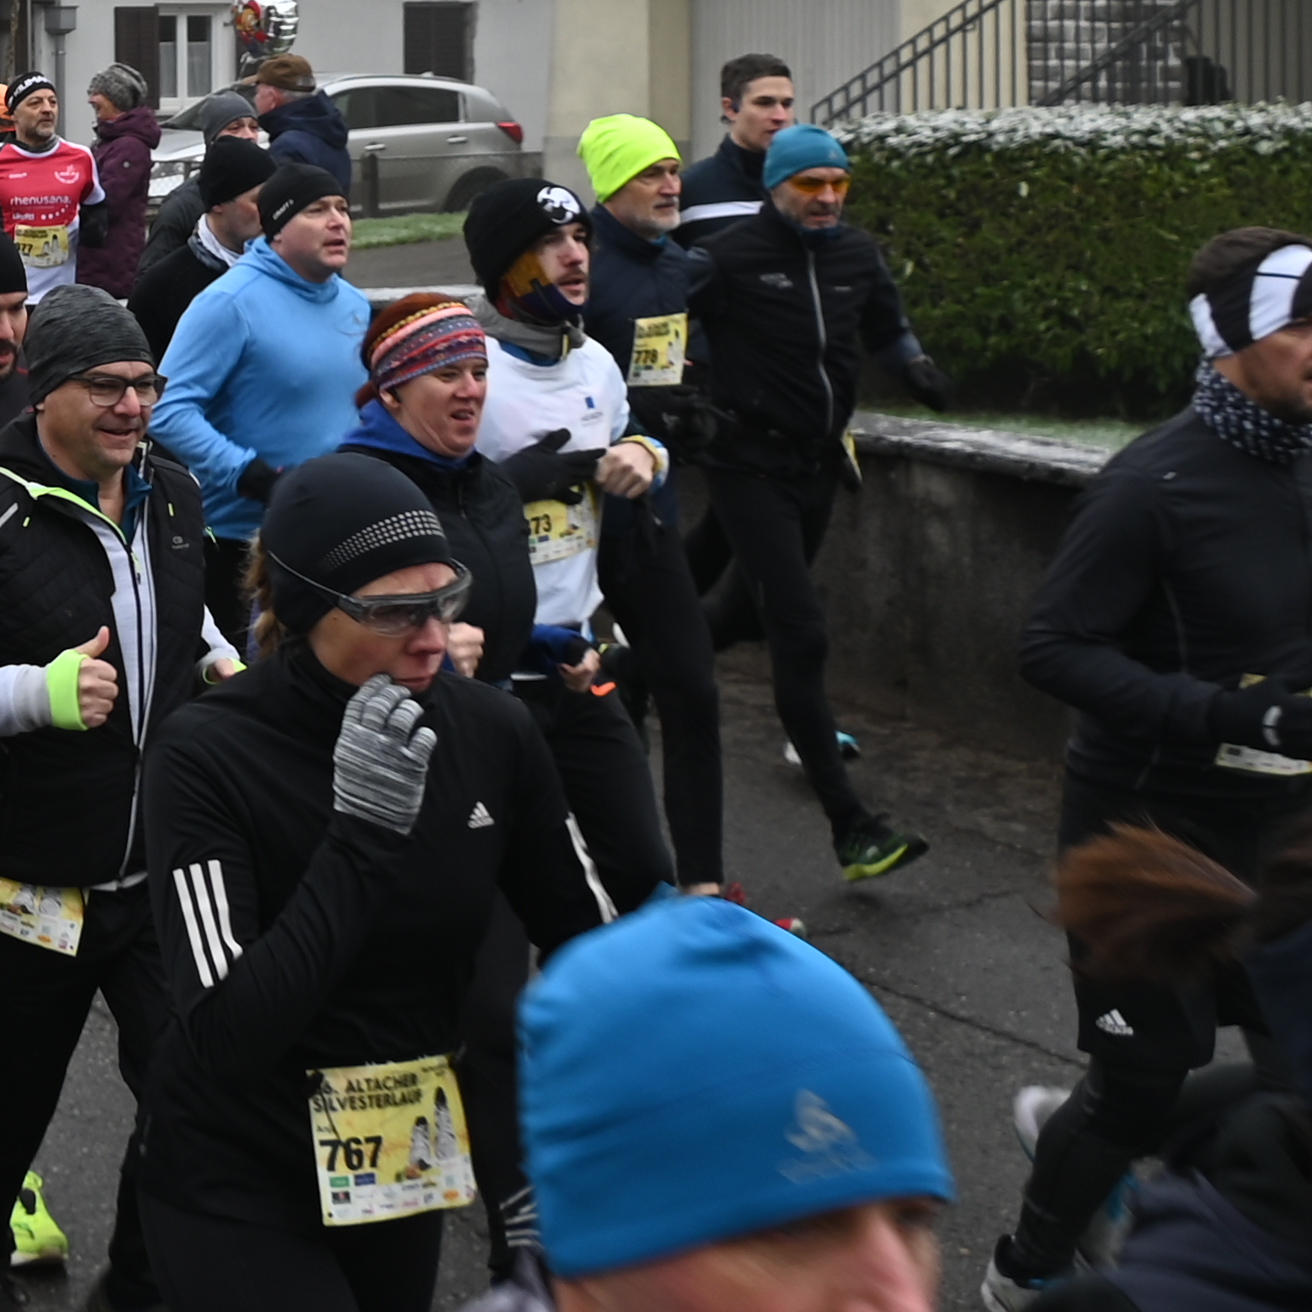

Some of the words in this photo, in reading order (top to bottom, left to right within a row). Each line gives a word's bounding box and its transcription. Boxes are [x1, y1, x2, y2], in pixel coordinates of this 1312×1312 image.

[345, 1072, 419, 1094] ALTACHER
[313, 1088, 423, 1113] SILVESTERLAUF
[318, 1135, 383, 1172] 767
